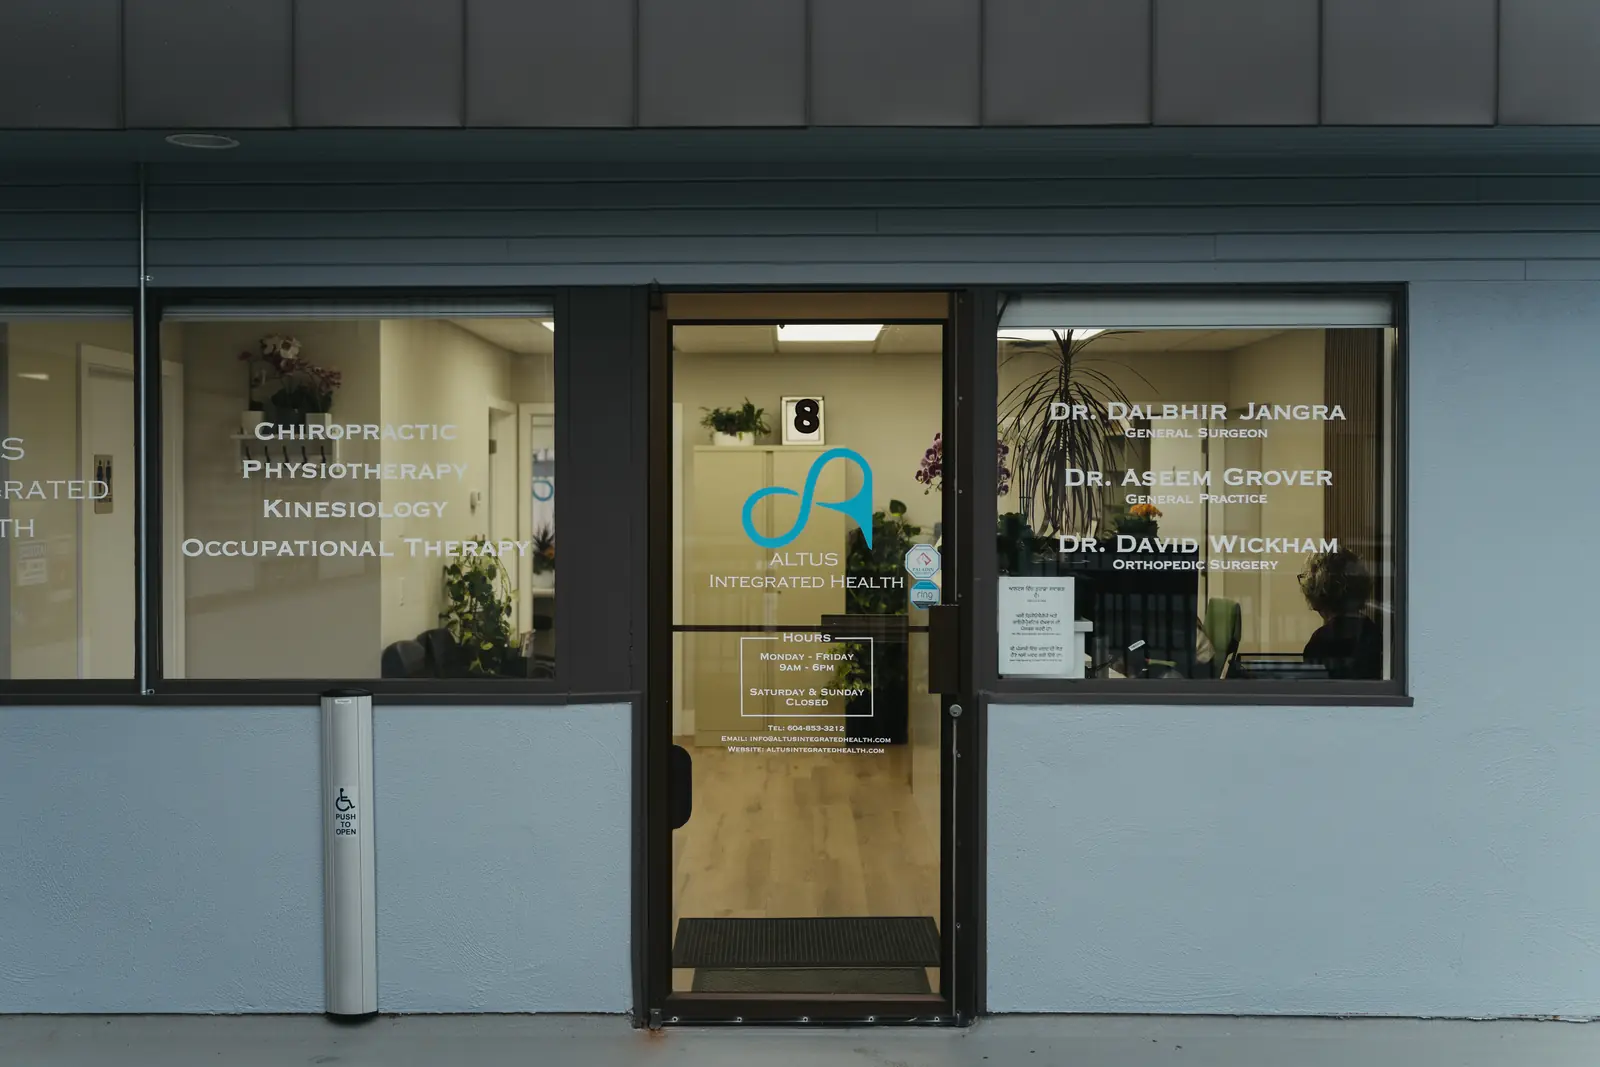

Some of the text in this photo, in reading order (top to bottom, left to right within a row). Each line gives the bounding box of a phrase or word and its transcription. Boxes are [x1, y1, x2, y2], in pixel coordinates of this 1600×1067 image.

[794, 398, 820, 433] 8
[1050, 403, 1096, 420] DR.
[1065, 469, 1111, 486] DR.
[0, 481, 108, 499] RATED
[1059, 535, 1105, 553] DR.
[770, 552, 838, 566] ALTUS
[917, 590, 933, 600] ring
[809, 688, 816, 696] &
